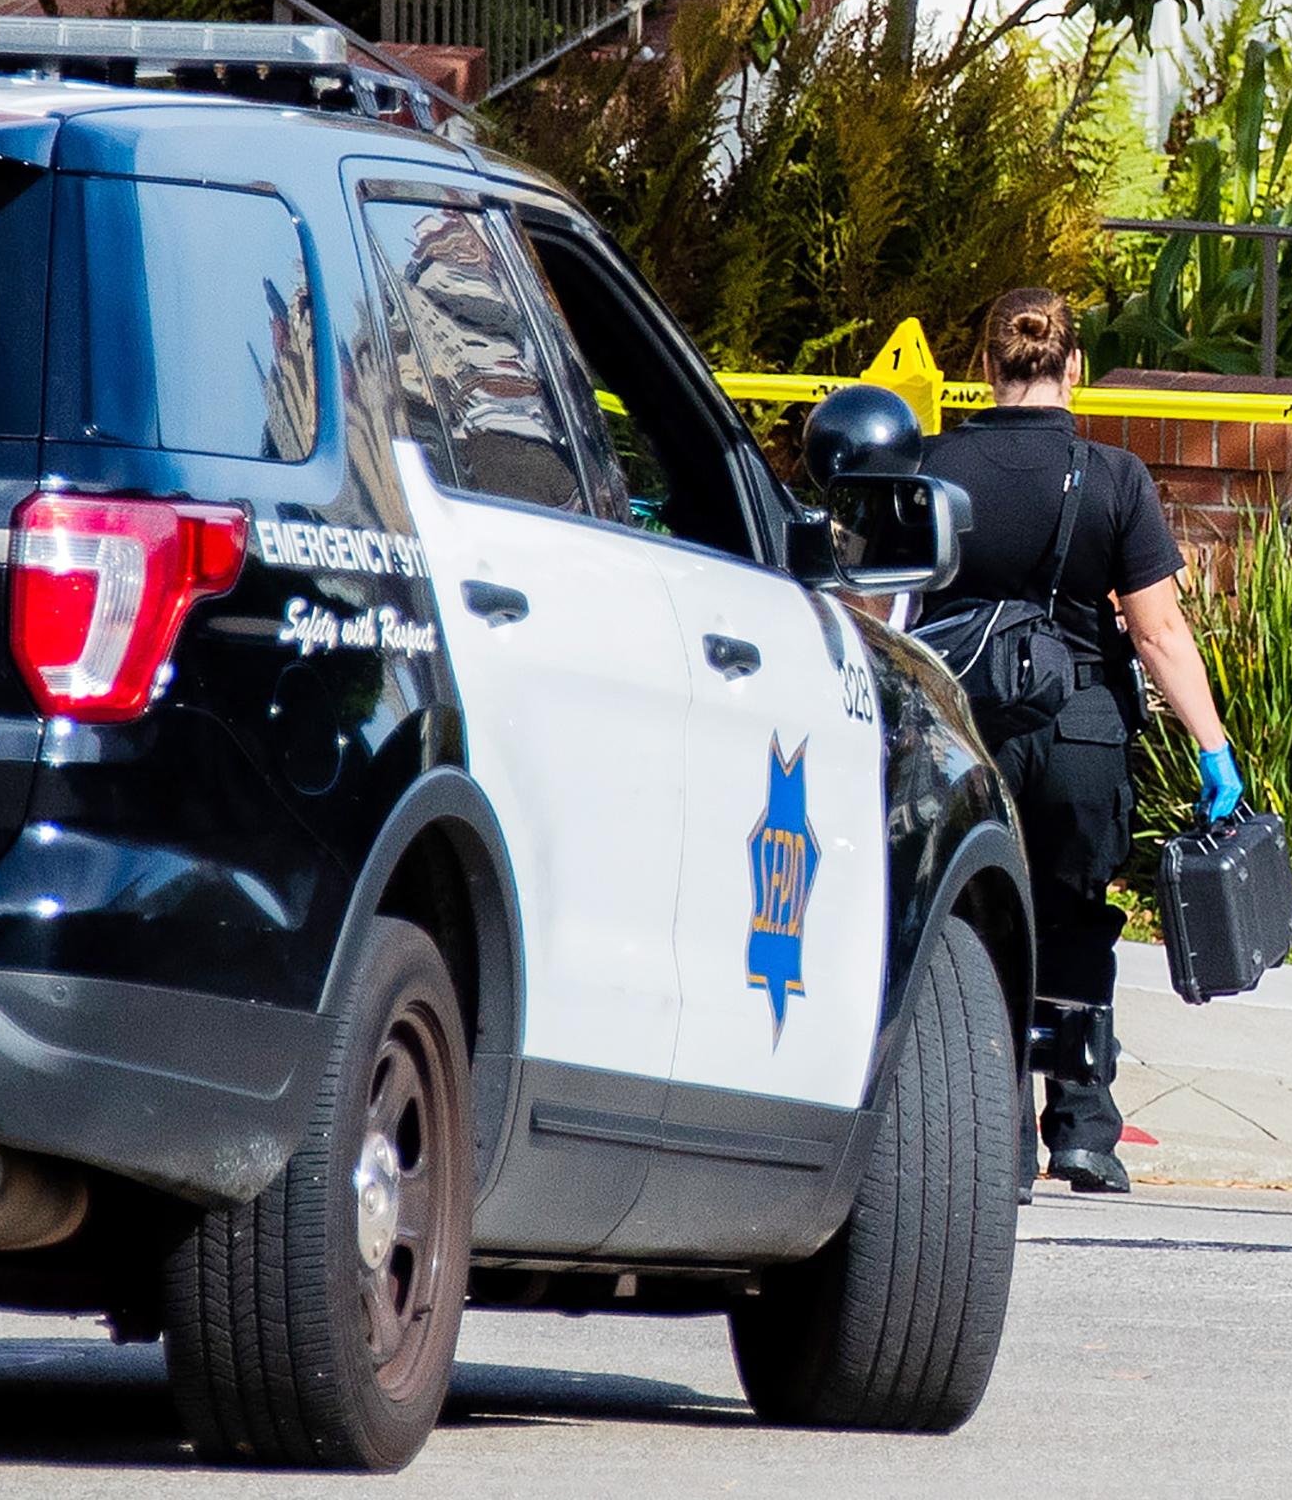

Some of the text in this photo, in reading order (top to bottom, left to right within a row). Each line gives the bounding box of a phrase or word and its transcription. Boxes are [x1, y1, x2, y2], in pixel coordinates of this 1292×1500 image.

[892, 347, 901, 370] 1
[279, 597, 438, 659] Safety with Respect
[837, 659, 873, 724] 328
